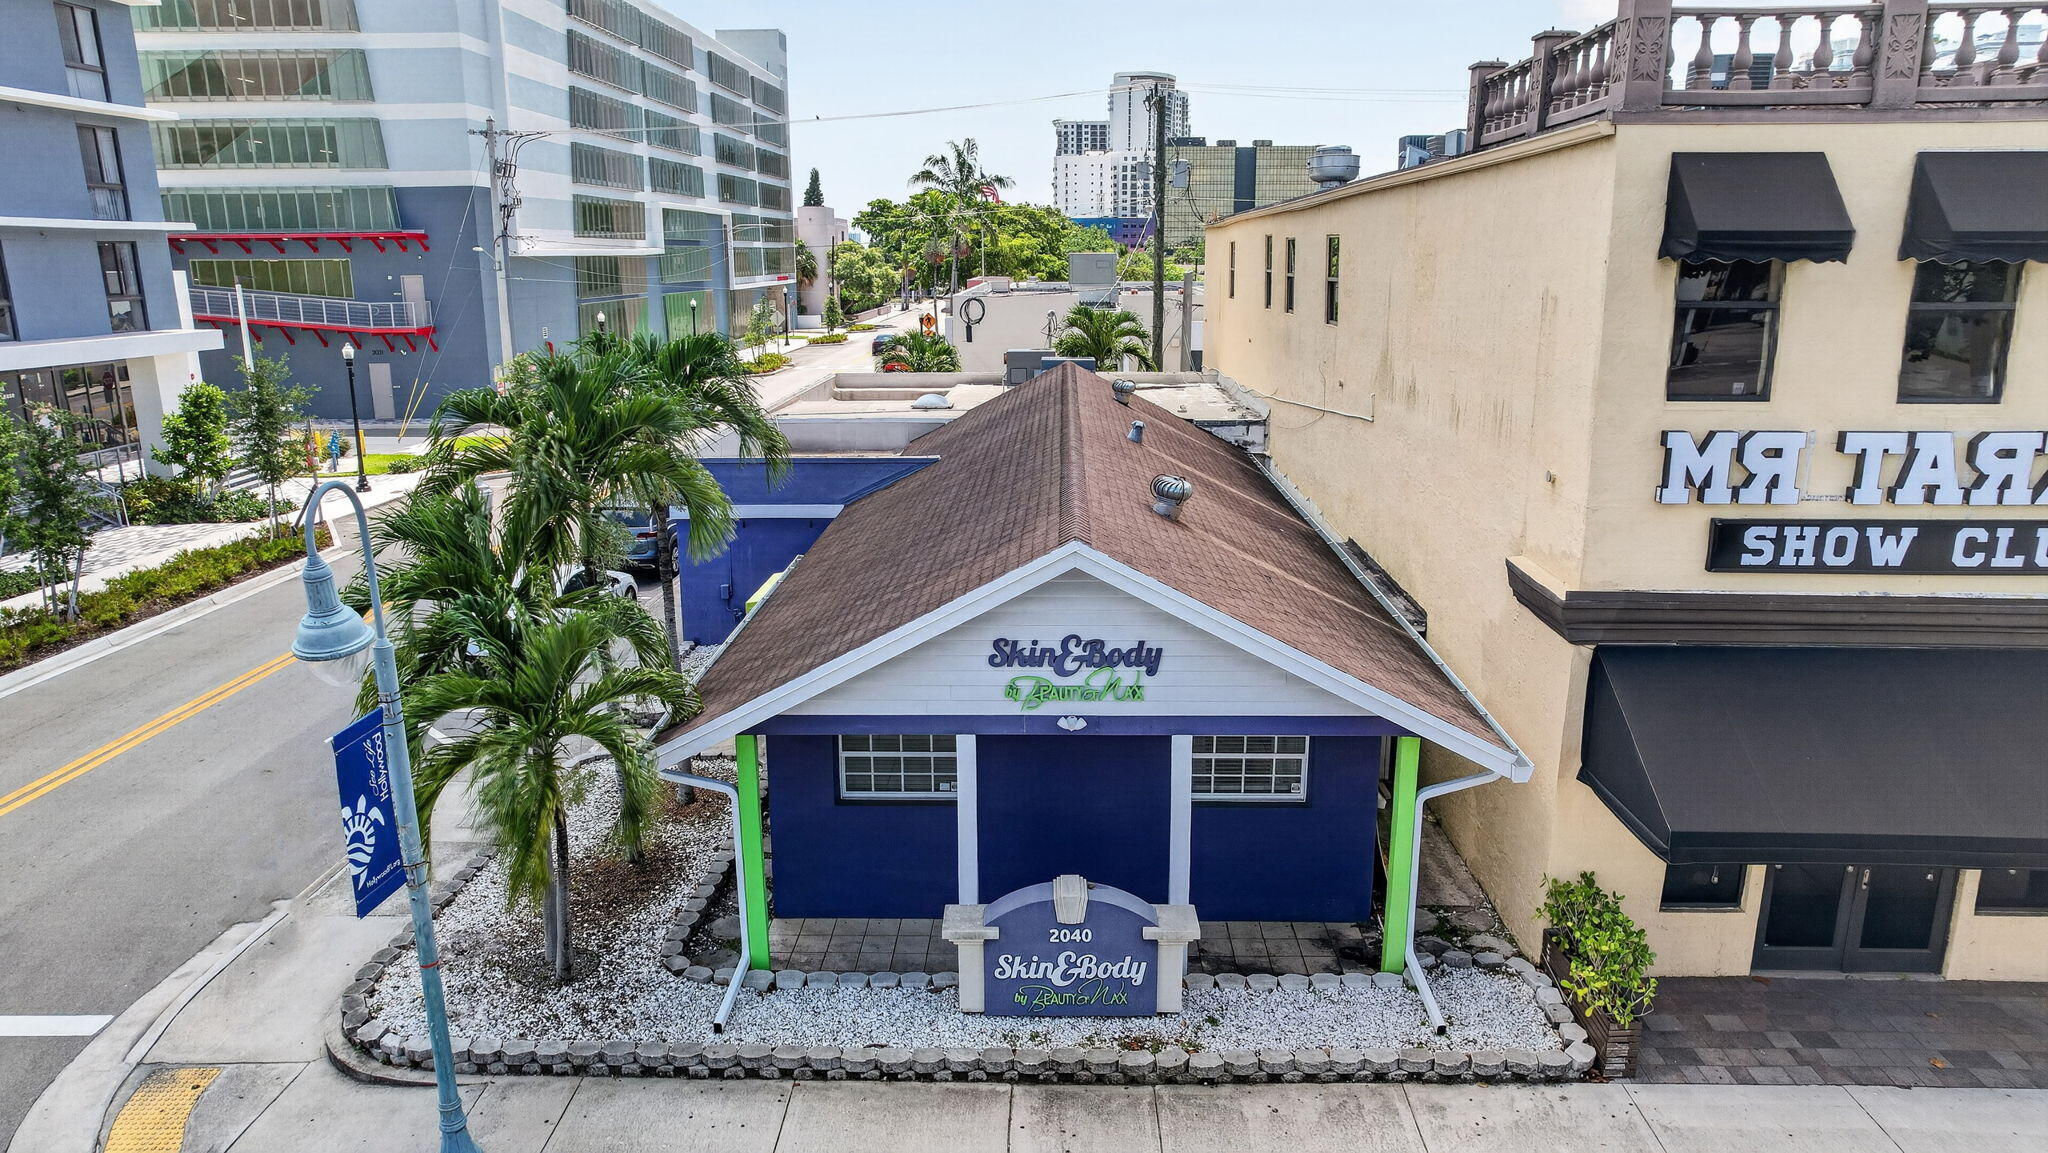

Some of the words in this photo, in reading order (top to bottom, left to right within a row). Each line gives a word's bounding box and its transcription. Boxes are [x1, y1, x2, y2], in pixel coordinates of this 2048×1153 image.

[1836, 431, 2048, 505] TAR
[1740, 526, 1918, 567] SHOW
[1005, 684, 1020, 702] by
[372, 732, 389, 802] Hollywood
[1049, 928, 1093, 943] 2040
[1014, 992, 1028, 1006] by
